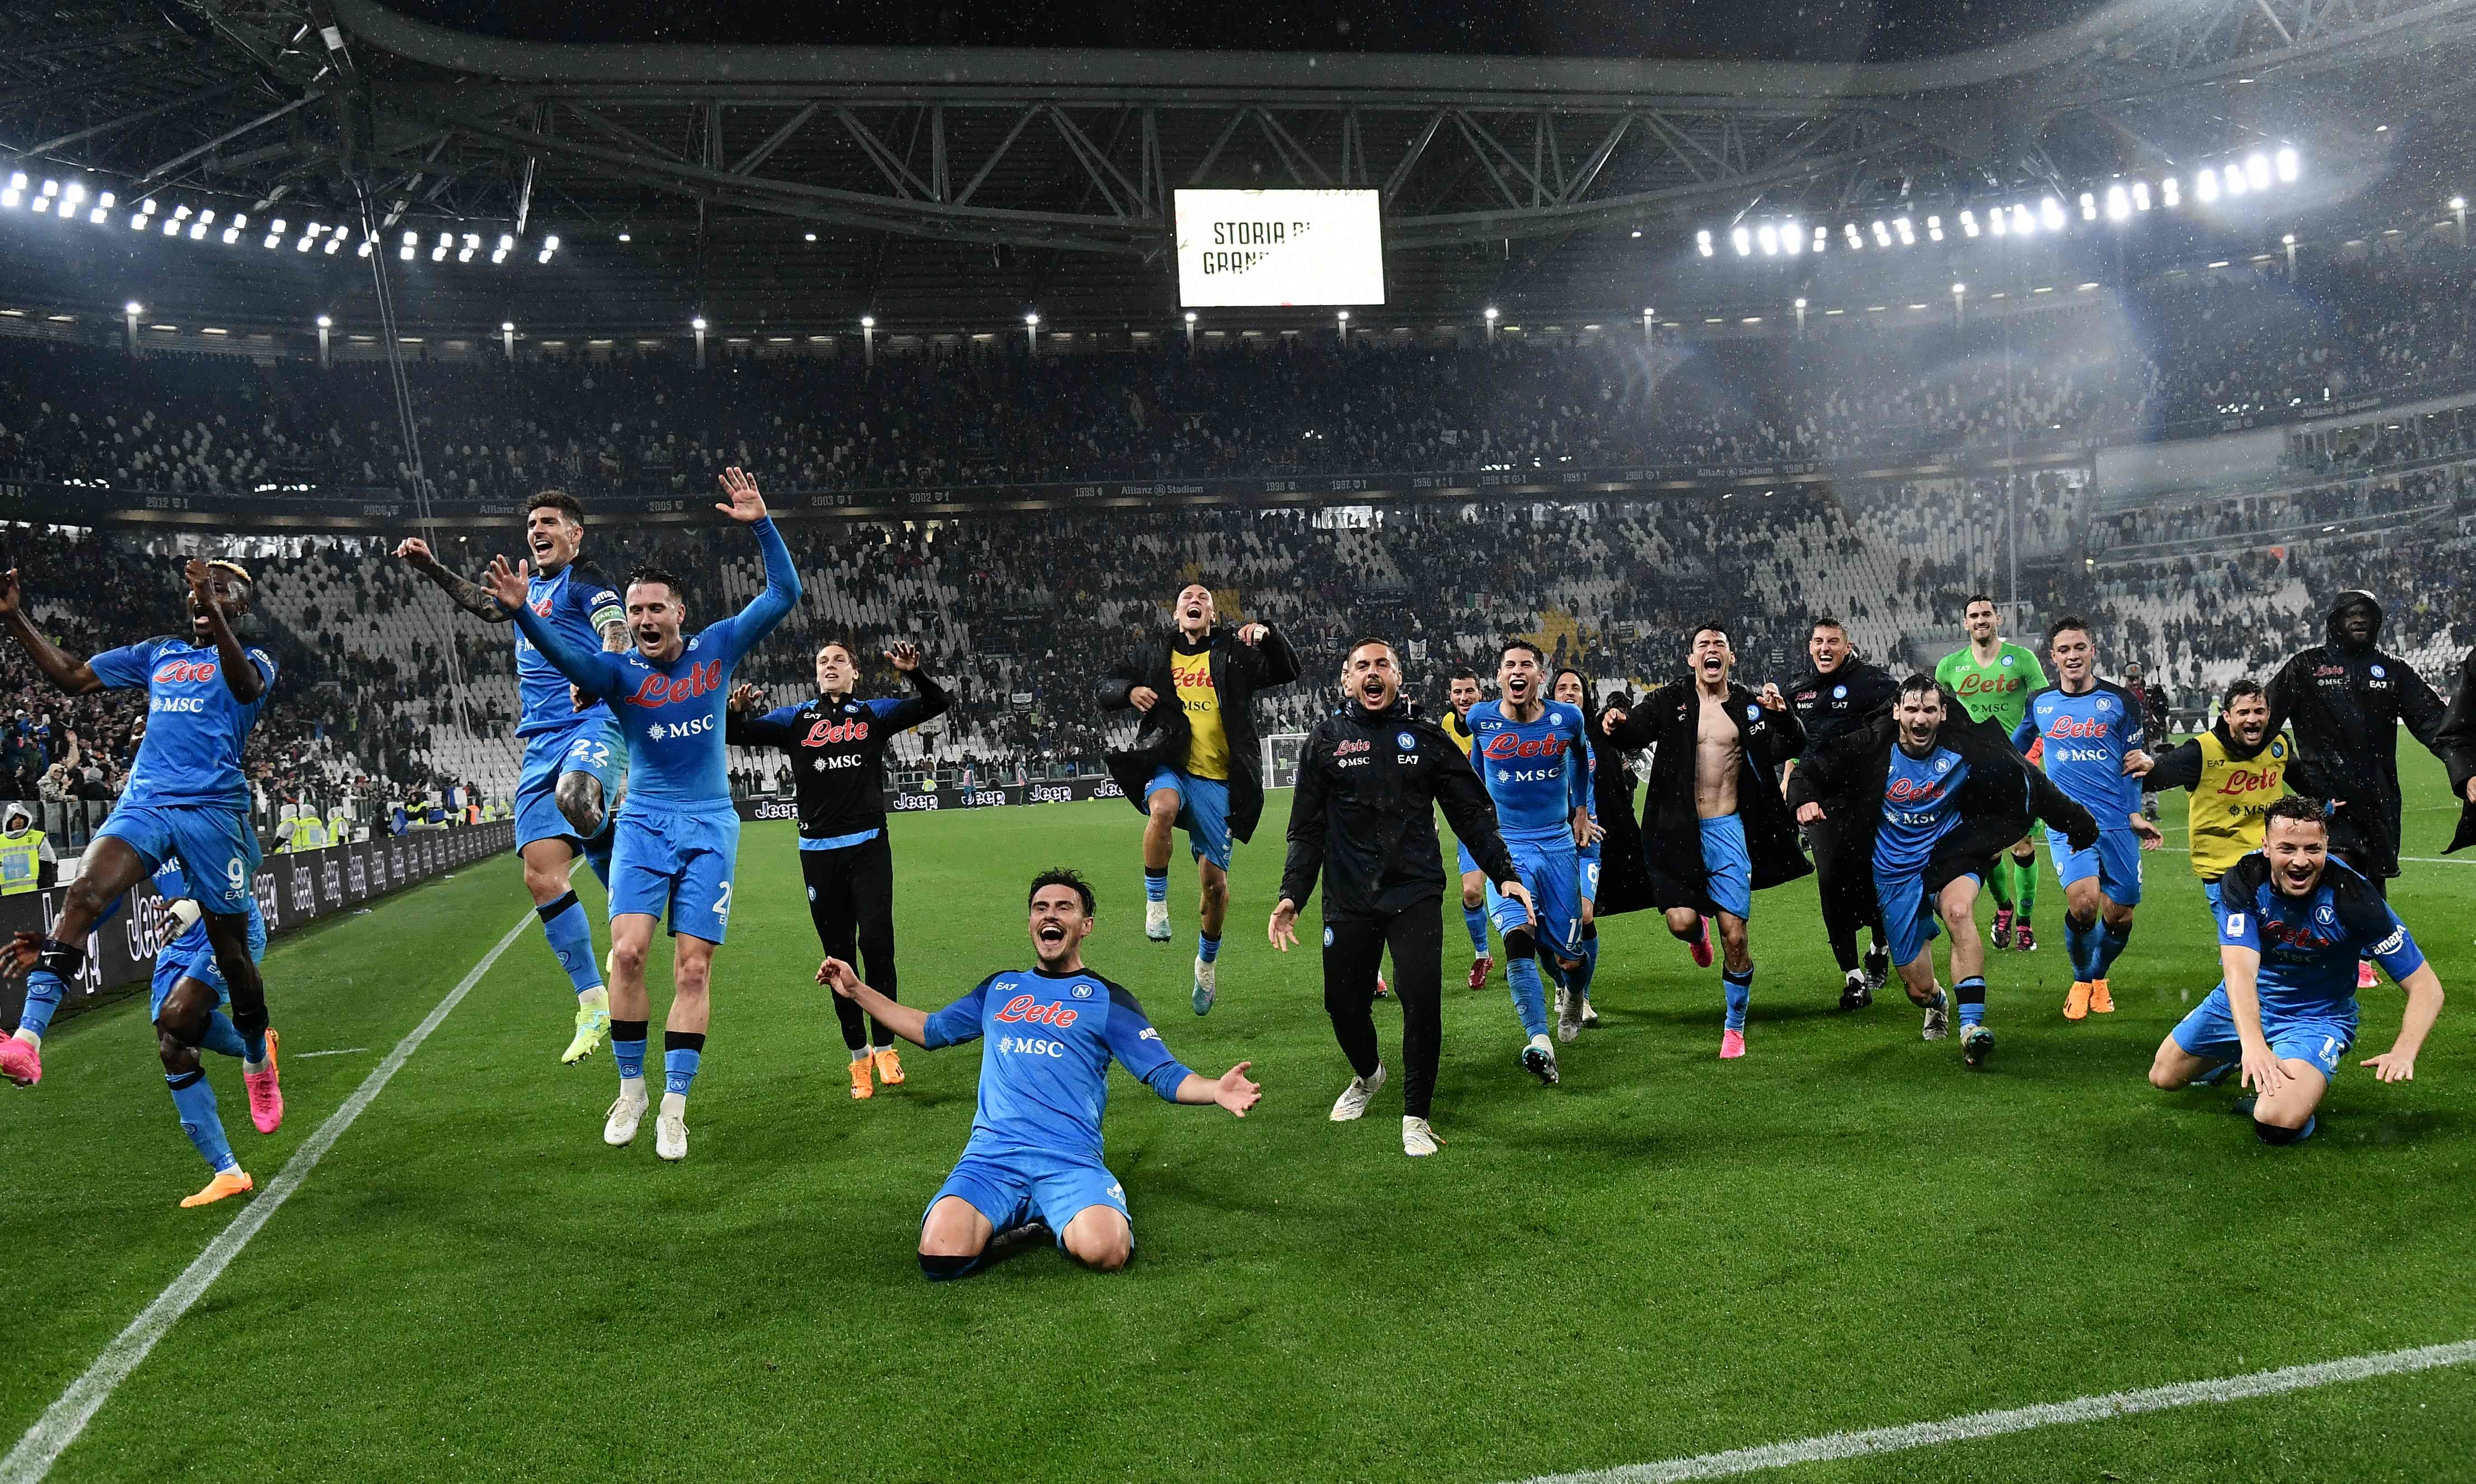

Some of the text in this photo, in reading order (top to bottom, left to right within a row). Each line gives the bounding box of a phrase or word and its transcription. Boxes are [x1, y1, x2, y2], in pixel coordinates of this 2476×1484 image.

[1214, 222, 1285, 244] STORIA
[1204, 252, 1269, 274] GRAN
[1121, 485, 1204, 495] Allianz Stadium
[1266, 482, 1285, 492] 1998
[1332, 480, 1350, 490] 1997
[146, 496, 169, 508] 2012
[811, 496, 833, 506] 2003
[909, 492, 931, 503] 2002
[363, 505, 387, 516] 2006
[480, 505, 514, 514] Allianz
[649, 501, 672, 512] 2005
[590, 590, 617, 605] amaz
[152, 659, 216, 684] Lete
[2312, 664, 2344, 677] Lete
[624, 658, 722, 709] Lete
[1956, 672, 2021, 697] Lete
[2369, 680, 2387, 689] EA7
[162, 697, 204, 713] MSC
[1182, 700, 1211, 711] MSC
[1981, 703, 2009, 713] MSC
[668, 713, 714, 738] MSC
[801, 717, 868, 747] Lete
[1480, 722, 1502, 730] EA7
[1748, 720, 1766, 735] EA7
[2045, 715, 2109, 739] Lete
[571, 739, 609, 767] 22
[1333, 739, 1371, 756] Lete
[1482, 732, 1571, 760] Lete
[580, 755, 603, 769] EA7
[828, 754, 862, 770] MSC
[1348, 756, 1370, 766] MSC
[1397, 754, 1419, 765] EA7
[2070, 749, 2108, 761] MSC
[2207, 759, 2226, 768] EA7
[1515, 767, 1560, 782] MSC
[2217, 767, 2277, 795] Lete
[1029, 784, 1071, 802] Jeep
[1094, 780, 1127, 798] Jee
[1885, 777, 1947, 803] Lete
[893, 792, 938, 811] Jeep
[961, 790, 1005, 806] Jeep
[755, 801, 799, 820] Jeep
[162, 857, 181, 875] MS
[228, 857, 244, 890] 9
[1587, 863, 1598, 884] 6
[225, 889, 245, 900] EA7
[290, 855, 316, 918] Jeep
[712, 881, 733, 916] 2
[127, 884, 169, 961] Jee
[2372, 924, 2406, 955] amazn
[207, 964, 225, 981] EA
[995, 982, 1019, 991] EA7
[994, 994, 1078, 1028] Lete
[1014, 1037, 1064, 1058] MSC
